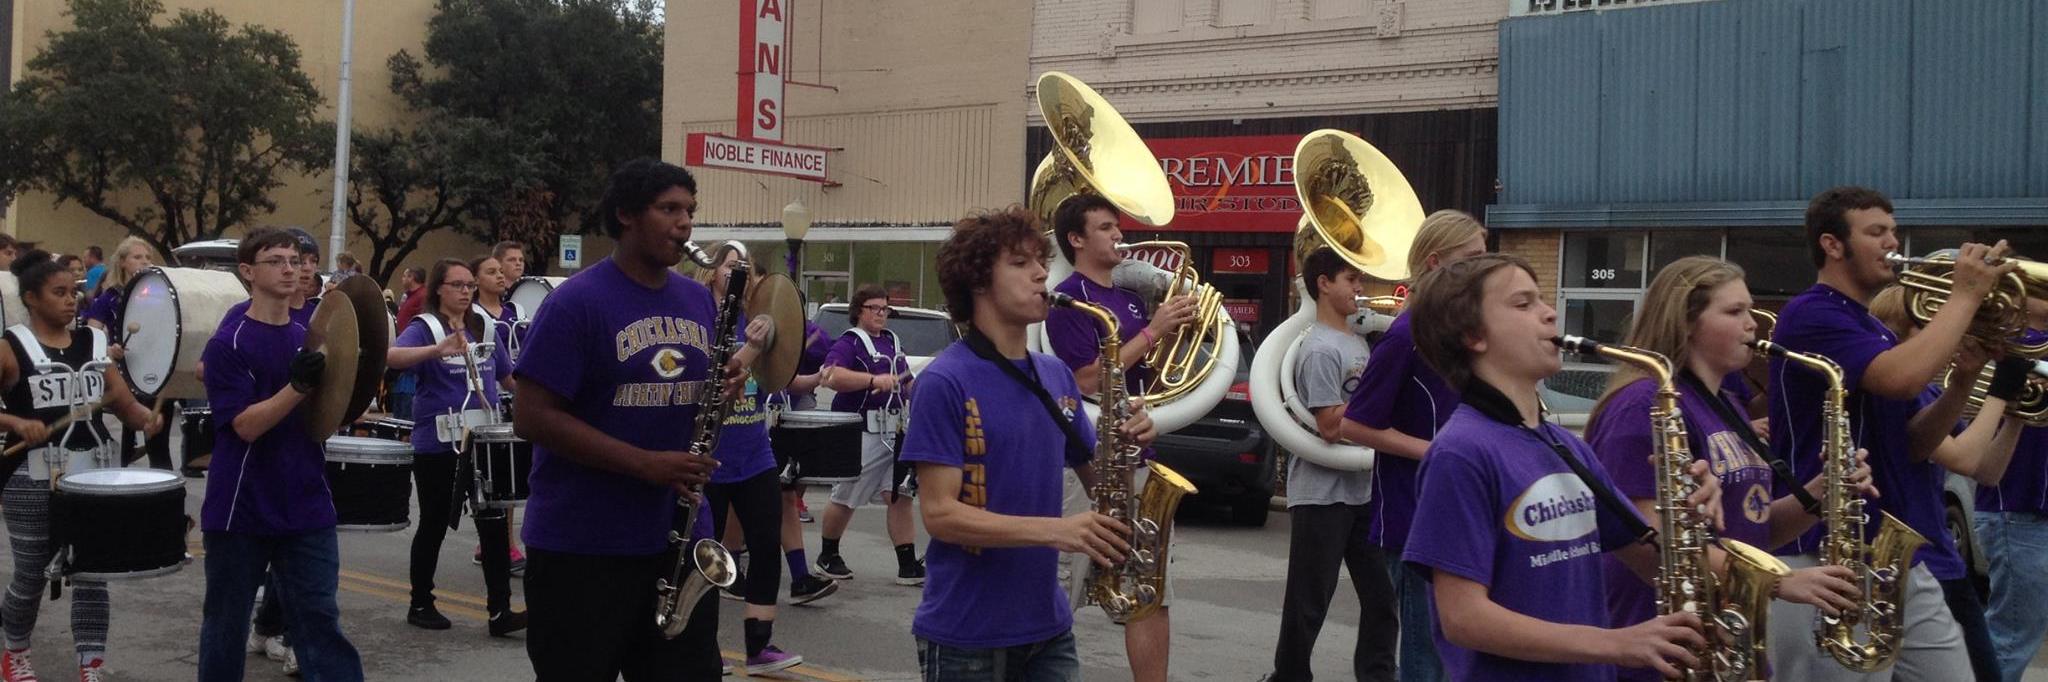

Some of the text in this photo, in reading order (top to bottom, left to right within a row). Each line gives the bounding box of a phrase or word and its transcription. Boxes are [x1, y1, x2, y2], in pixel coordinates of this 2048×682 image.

[705, 142, 822, 171] NOBLE FINANCE
[1160, 155, 1295, 186] REMIE
[1217, 196, 1300, 211] STUD
[1230, 256, 1250, 268] 303
[1591, 268, 1615, 279] 305
[1529, 549, 1569, 567] Middle
